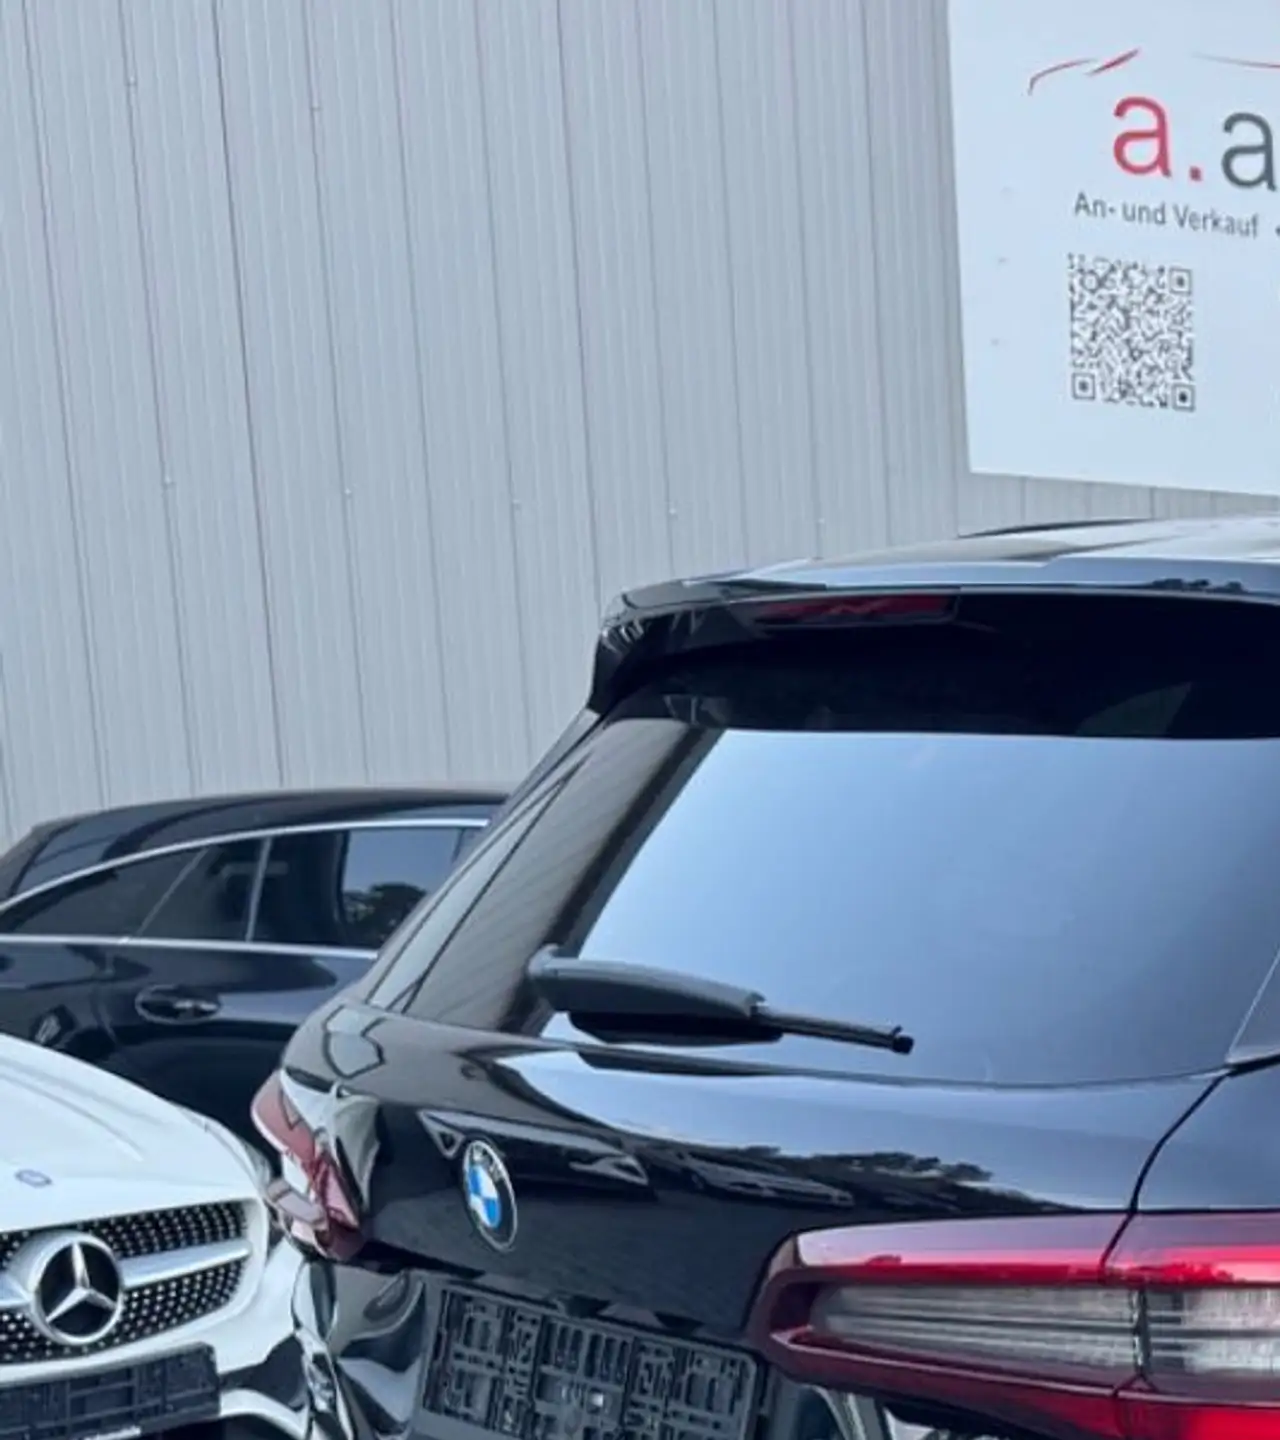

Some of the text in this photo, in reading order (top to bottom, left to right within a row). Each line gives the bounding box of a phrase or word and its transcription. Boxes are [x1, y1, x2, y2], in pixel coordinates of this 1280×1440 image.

[1074, 191, 1114, 218] An-
[1121, 201, 1167, 226] und
[1172, 203, 1260, 239] Verkauf
